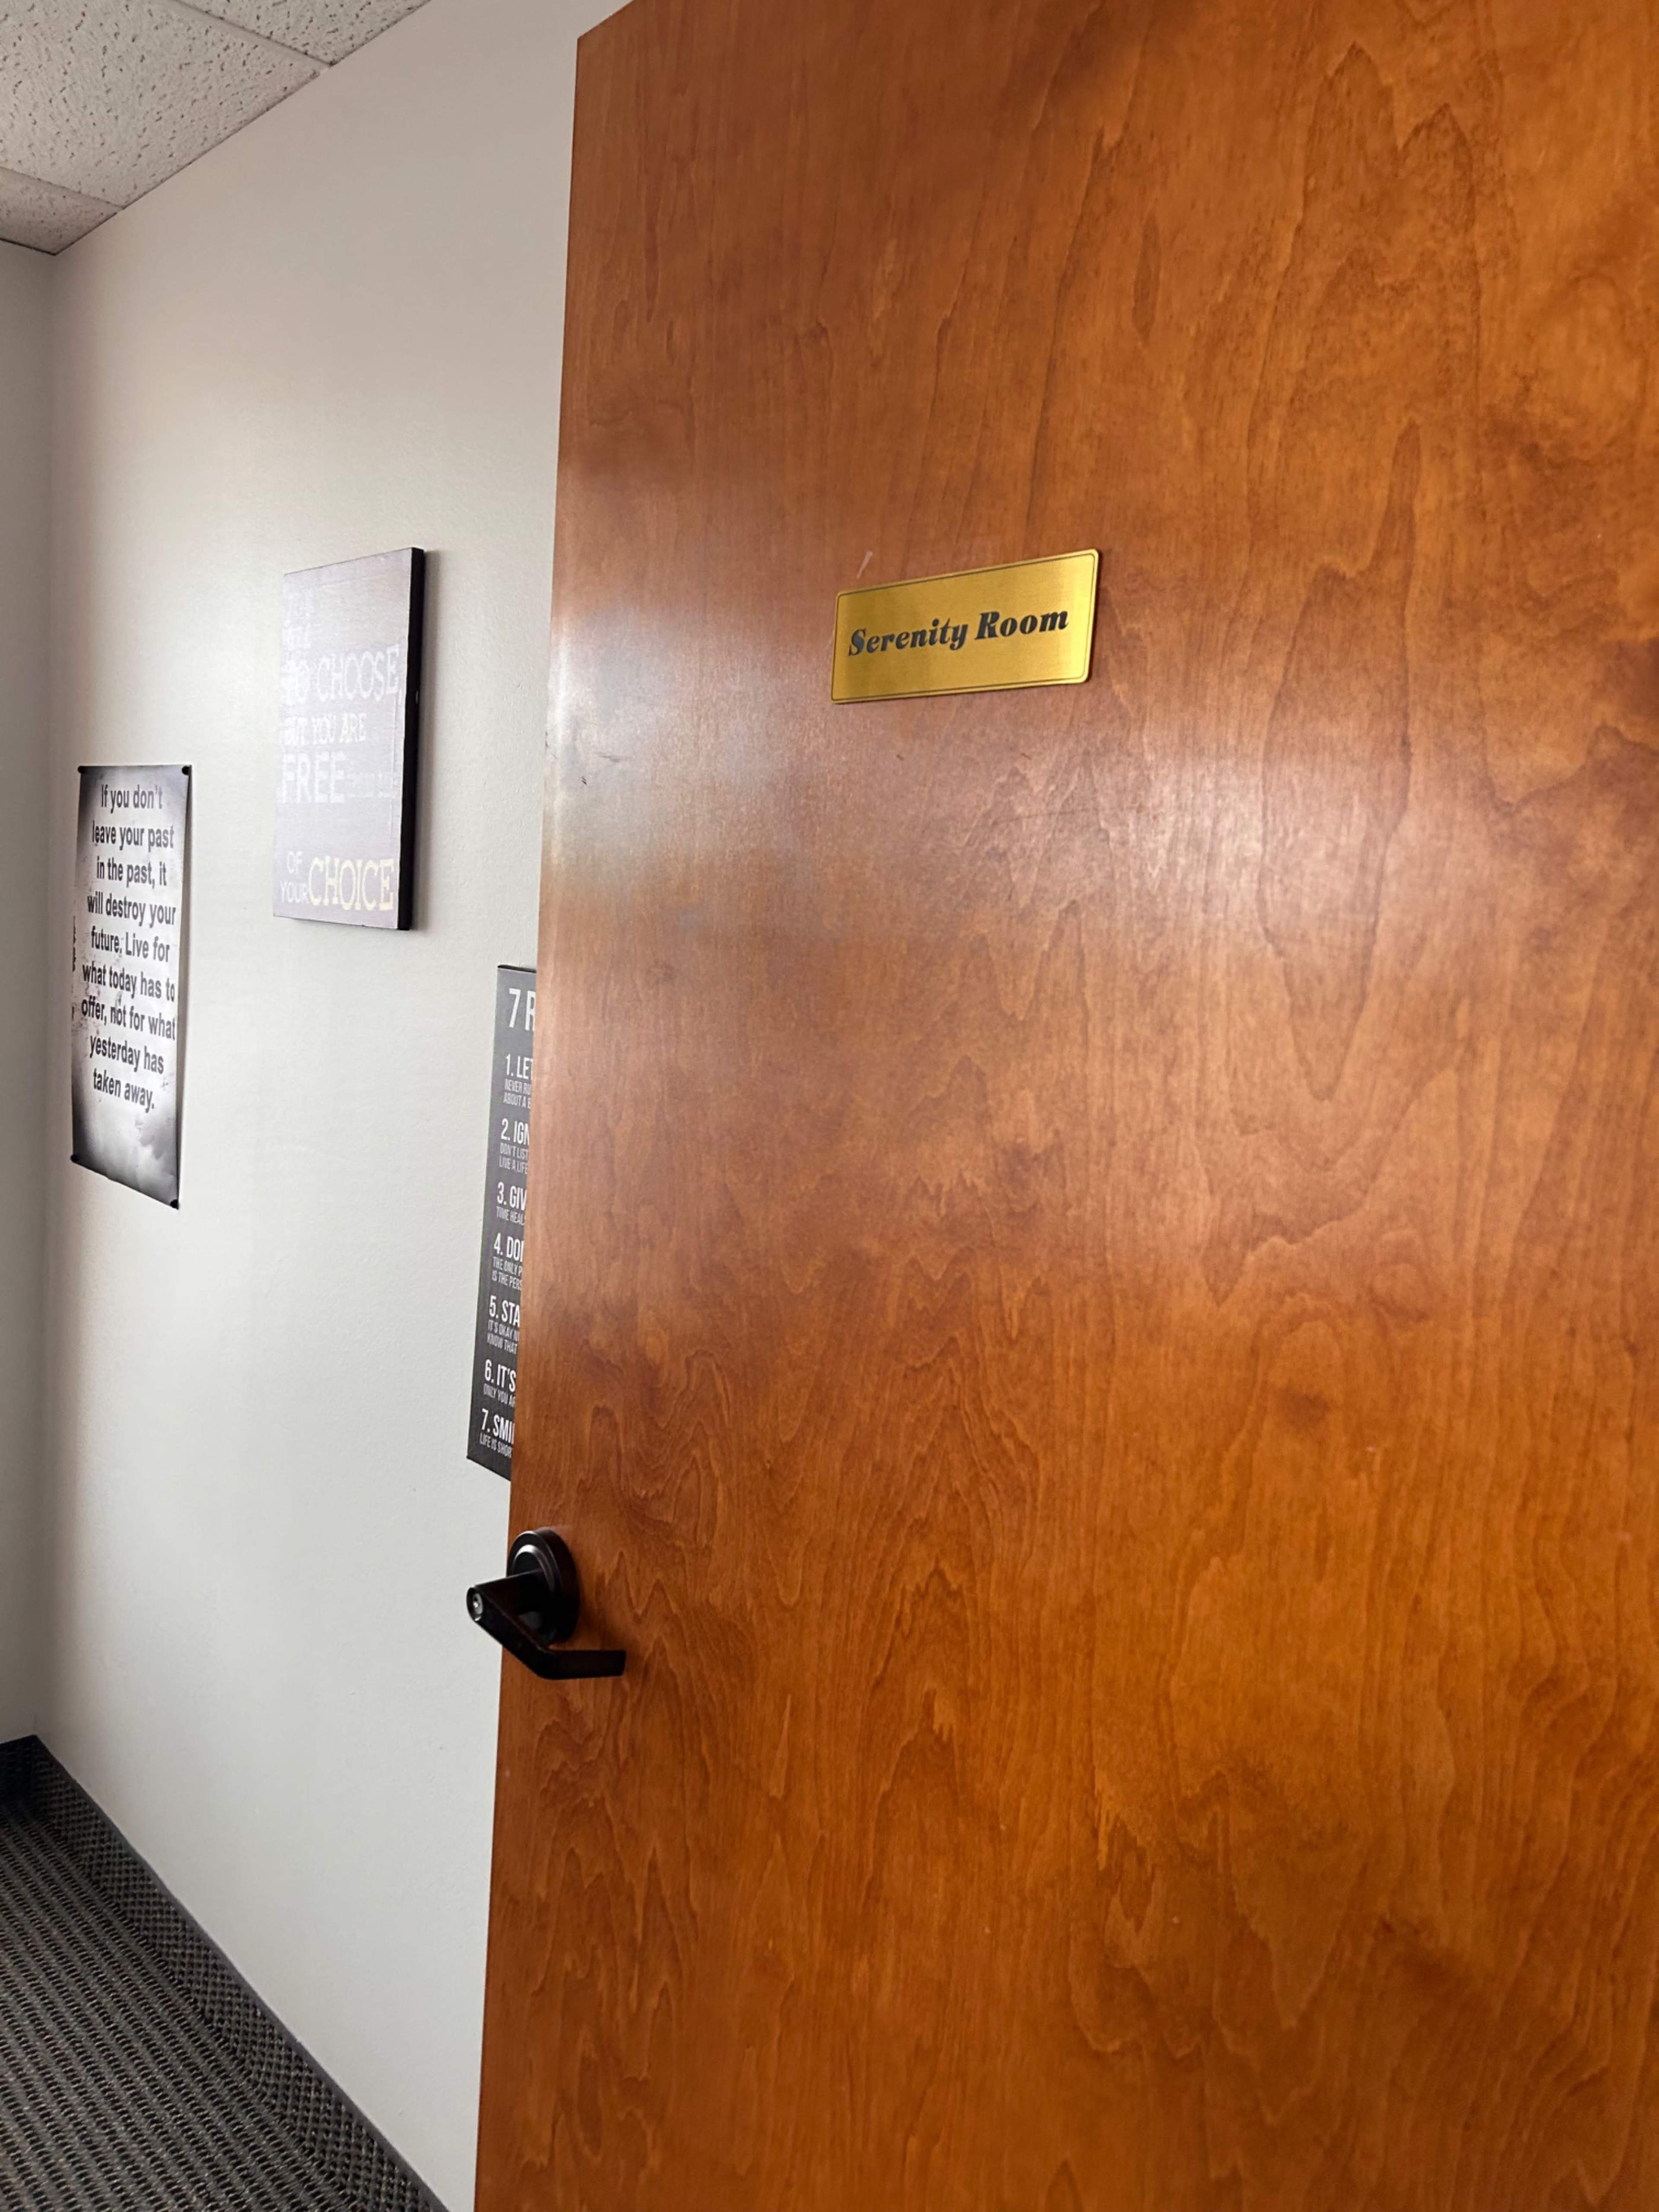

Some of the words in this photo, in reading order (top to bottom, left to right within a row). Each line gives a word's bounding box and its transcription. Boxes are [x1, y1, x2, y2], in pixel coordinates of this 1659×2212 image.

[848, 618, 968, 657] Serenity
[974, 610, 1069, 640] Room
[317, 644, 399, 702] CHOOSE
[311, 715, 337, 744] YOU
[339, 712, 367, 743] ARE
[282, 751, 346, 803] FREE
[101, 784, 109, 808] If
[111, 788, 129, 814] you
[133, 785, 163, 810] don't
[92, 820, 116, 845] leave
[119, 827, 145, 851] your
[148, 825, 174, 852] past
[97, 856, 105, 880] in
[107, 857, 124, 881] the
[126, 862, 155, 889] past,
[159, 861, 167, 886] it
[287, 850, 303, 874] OF
[280, 880, 308, 904] YOUR
[308, 855, 394, 911] CHOICE
[87, 891, 103, 914] will
[106, 893, 146, 928] destroy
[149, 903, 176, 928] your
[91, 925, 122, 953] future.
[125, 932, 149, 959] Live
[153, 935, 170, 963] for
[82, 963, 106, 986] what
[109, 967, 137, 999] today
[140, 971, 162, 999] has
[166, 978, 175, 1002] to
[81, 998, 107, 1026] offer,
[110, 1005, 127, 1028] not
[130, 1007, 146, 1032] for
[148, 1013, 176, 1040] what
[509, 988, 521, 1028] 7
[90, 1034, 140, 1072] yesterday
[144, 1046, 164, 1075] has
[506, 1054, 514, 1077] 1.
[93, 1068, 121, 1098] taken
[124, 1083, 155, 1113] away.
[501, 1118, 510, 1141] 2.
[497, 1182, 506, 1205] 3.
[510, 1185, 527, 1211] GIV
[494, 1233, 503, 1255] 4.
[489, 1295, 499, 1319] 5.
[502, 1300, 520, 1328] STA
[484, 1359, 494, 1383] 6.
[497, 1363, 516, 1392] IT'S
[481, 1408, 490, 1433] 7.
